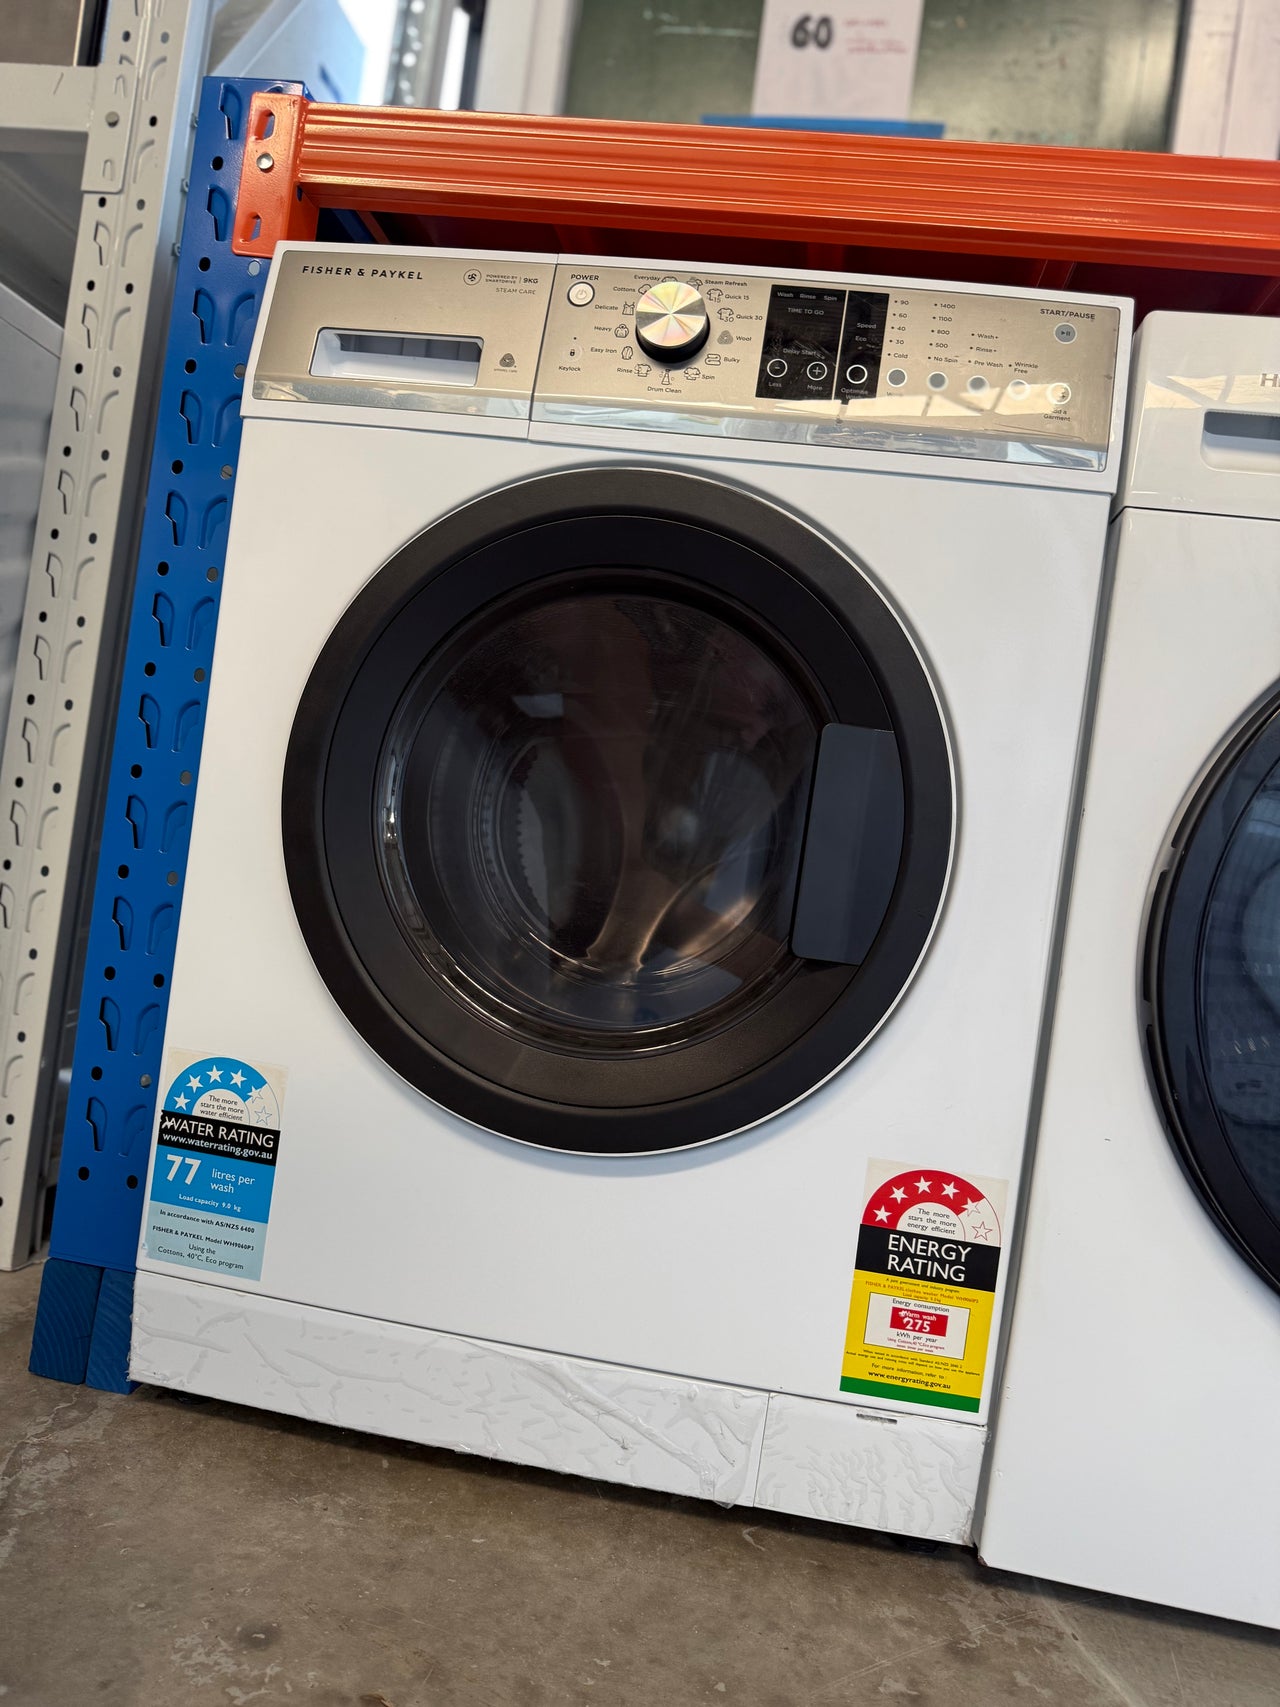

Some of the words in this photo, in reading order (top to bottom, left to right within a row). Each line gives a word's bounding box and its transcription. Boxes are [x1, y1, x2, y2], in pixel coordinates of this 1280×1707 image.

[791, 14, 833, 49] 60
[302, 265, 351, 276] FISHER
[357, 268, 365, 277] &
[371, 269, 423, 280] PAYKEL
[634, 274, 660, 282] Everyday
[1040, 308, 1096, 320] START/PAUSE
[856, 322, 877, 330] Speed
[944, 356, 958, 364] Spin
[986, 361, 1003, 369] Wash
[1014, 361, 1039, 369] Wrinkle
[1260, 373, 1280, 388] H
[1043, 414, 1071, 422] Garment
[200, 1101, 215, 1109] stars
[209, 1094, 221, 1103] The
[221, 1098, 238, 1106] more
[200, 1109, 217, 1117] water
[218, 1112, 243, 1121] efficient
[164, 1116, 214, 1138] WATER
[218, 1126, 275, 1148] RATING
[162, 1133, 273, 1160] www.waterrating.gov.au
[166, 1154, 201, 1185] 77
[211, 1168, 236, 1182] litres
[238, 1175, 256, 1185] per
[210, 1182, 234, 1193] wash
[178, 1193, 194, 1202] Load
[194, 1197, 219, 1208] capacity
[167, 1211, 200, 1223] accordance
[215, 1221, 239, 1231] AS/NZS
[152, 1225, 173, 1235] FISHER
[180, 1230, 203, 1241] PAYKEL
[205, 1236, 223, 1245] Model
[907, 1223, 928, 1232] energy
[931, 1226, 955, 1235] efficient
[188, 1243, 204, 1255] Using
[206, 1247, 216, 1255] the
[888, 1234, 972, 1262] ENERGY
[206, 1256, 217, 1265] Eco
[218, 1260, 244, 1271] program
[887, 1254, 966, 1282] RATING
[892, 1298, 911, 1307] Energy
[914, 1302, 950, 1314] consumption
[902, 1311, 920, 1319] Warm
[922, 1314, 937, 1322] wash
[903, 1317, 931, 1333] 275
[896, 1331, 911, 1339] kWh
[925, 1337, 938, 1345] year
[868, 1371, 951, 1390] www.energyrating.gov.au
